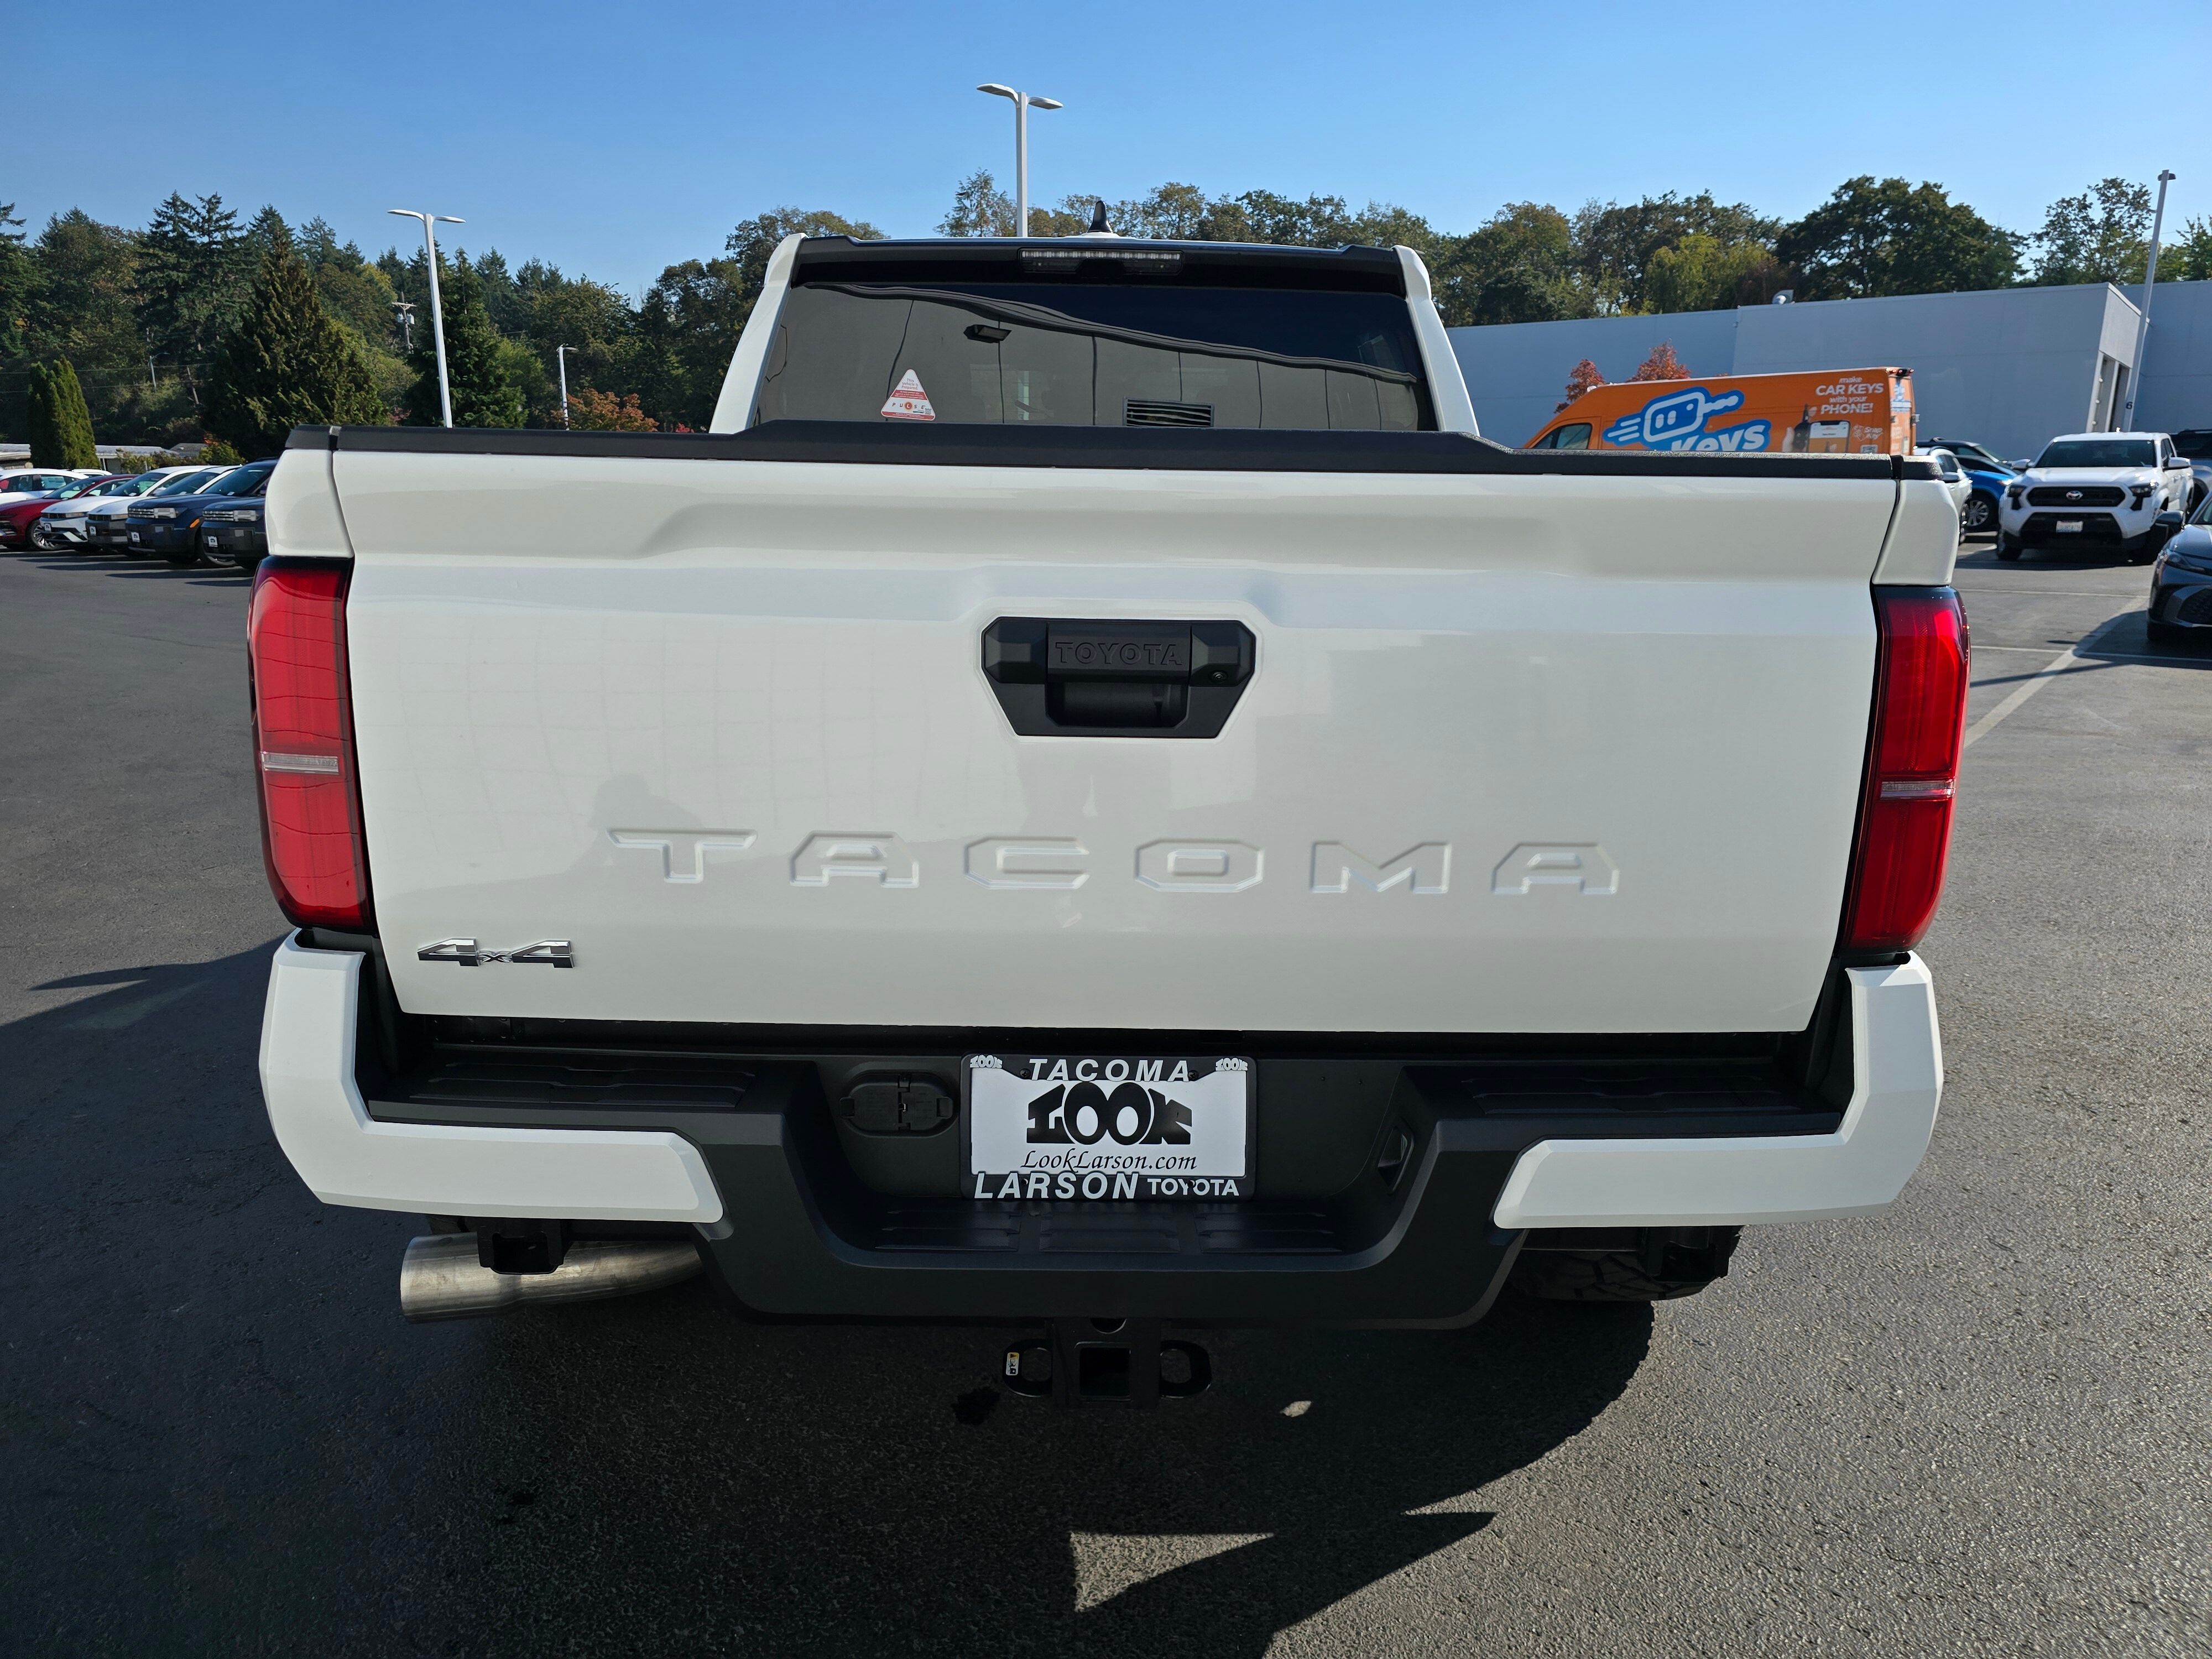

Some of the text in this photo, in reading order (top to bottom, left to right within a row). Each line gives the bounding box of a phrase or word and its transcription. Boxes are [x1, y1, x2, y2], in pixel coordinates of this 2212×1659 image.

[1815, 383, 1884, 396] CAR KEYS
[1820, 403, 1874, 415] PHONE!
[1055, 641, 1182, 665] TOYOTA
[607, 828, 1620, 895] TACOMA
[1029, 1058, 1190, 1082] TACOMA
[1026, 1081, 1192, 1145] LOOK
[1020, 1148, 1197, 1173] LookLarson.com
[974, 1172, 1240, 1199] LARSON TOYOTA
